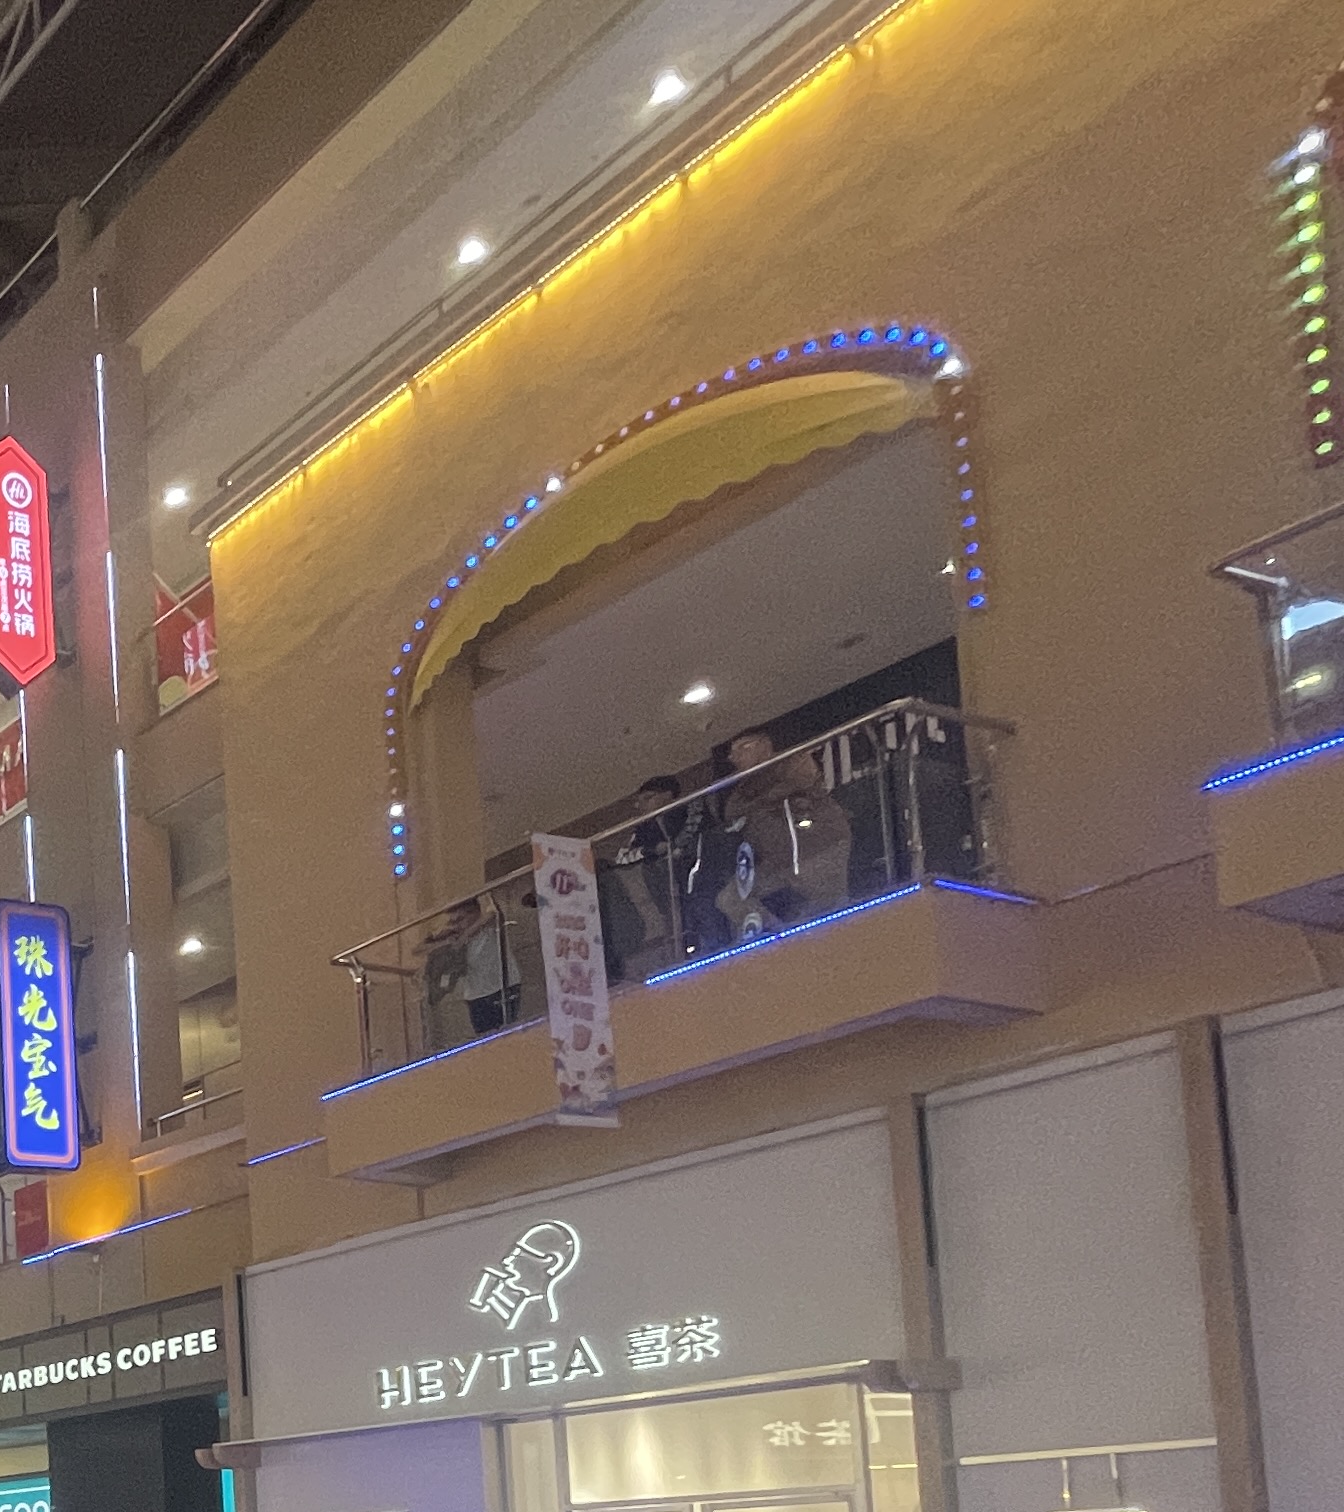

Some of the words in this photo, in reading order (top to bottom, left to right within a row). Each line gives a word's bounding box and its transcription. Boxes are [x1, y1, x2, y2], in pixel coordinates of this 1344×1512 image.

[8, 511, 36, 639] 海底捞火锅
[13, 935, 60, 1131] 珠光宝气
[116, 1328, 218, 1371] COFFEE
[377, 1336, 604, 1409] HEYTEA
[627, 1315, 720, 1371] 喜茶
